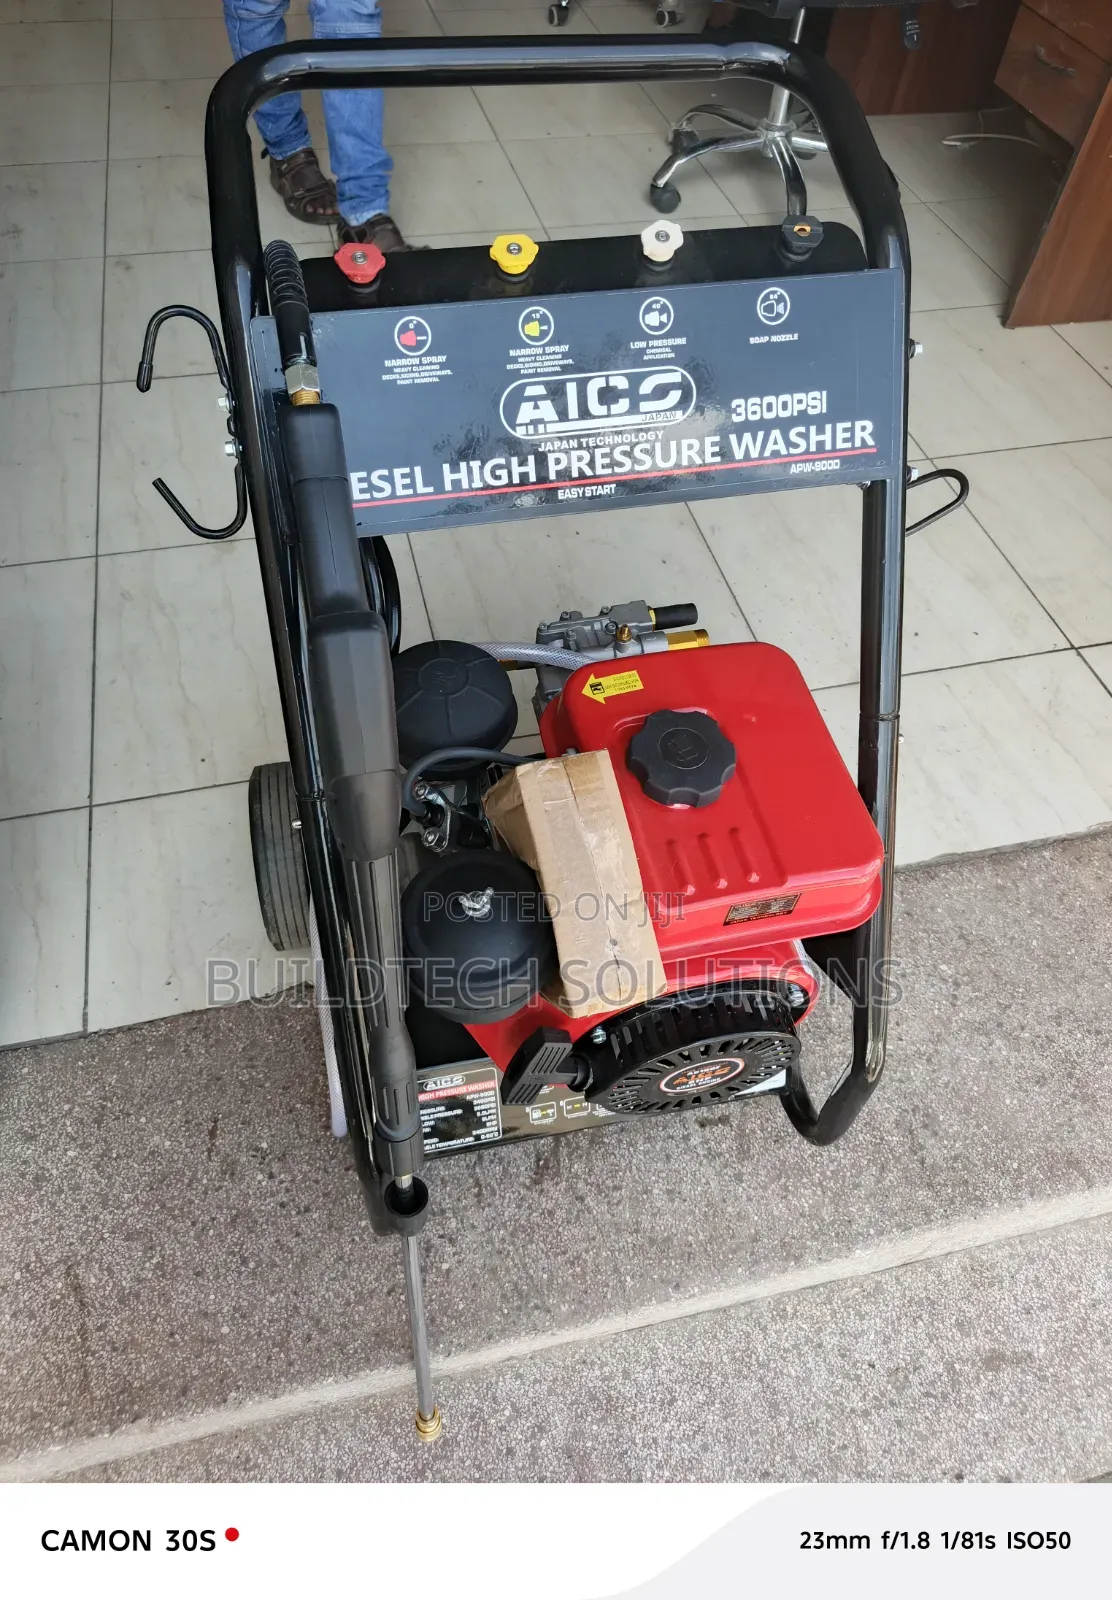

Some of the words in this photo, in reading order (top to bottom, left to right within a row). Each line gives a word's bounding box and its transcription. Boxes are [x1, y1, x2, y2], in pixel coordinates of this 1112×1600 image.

[630, 340, 647, 349] LOW
[648, 338, 687, 347] PRESSURE
[749, 336, 769, 344] SOAP
[770, 334, 798, 342] NOZZLE
[509, 348, 543, 356] NARROW
[544, 344, 570, 354] SPRAY
[384, 358, 420, 368] NARROW
[422, 355, 447, 364] SPRAY
[412, 364, 440, 372] CLEANING
[515, 371, 683, 430] AICS
[731, 390, 828, 423] 3600PSI
[641, 411, 677, 423] JAPAN
[538, 439, 578, 452] JAPAN
[580, 430, 664, 448] TECHNOLOGY
[349, 466, 435, 501] ESEL
[442, 454, 537, 491] HIGH
[547, 435, 721, 481] PRESSURE
[729, 419, 875, 461] WASHER
[558, 485, 585, 500] EASY
[585, 483, 617, 496] START
[435, 1087, 468, 1098] PRESSURE
[468, 1081, 496, 1092] WASHER
